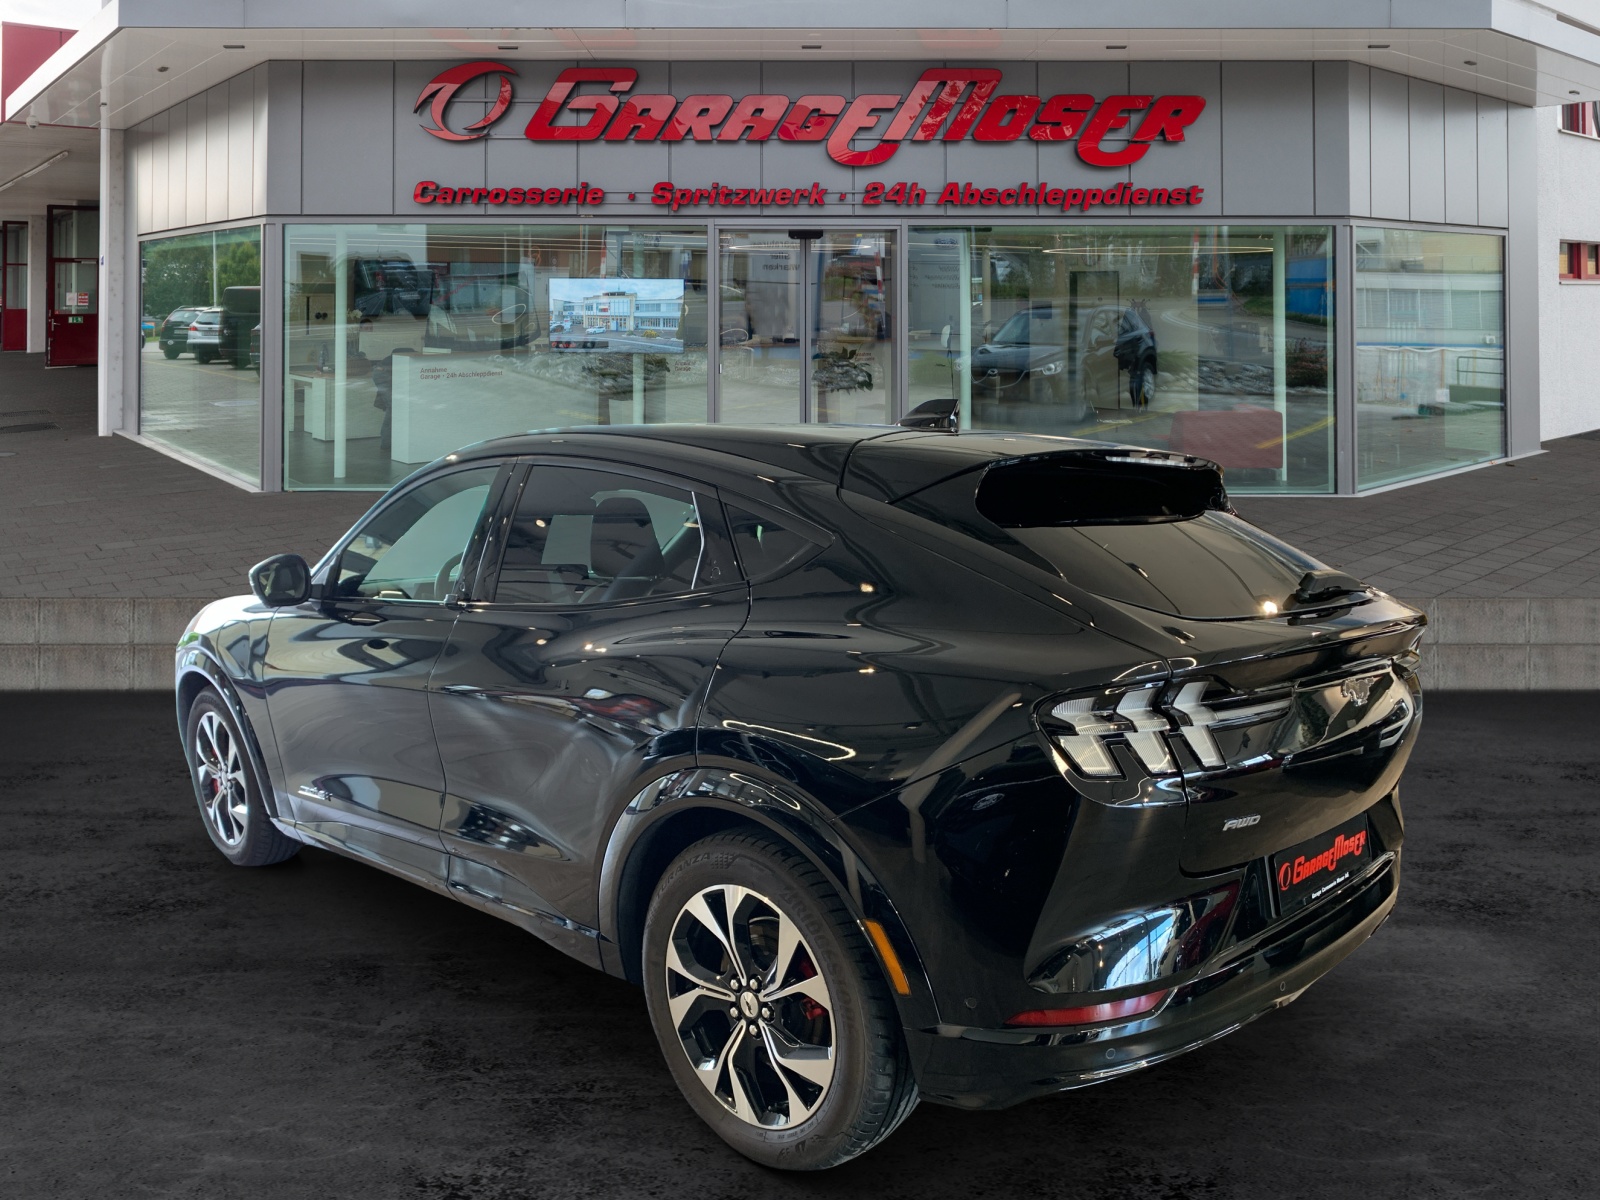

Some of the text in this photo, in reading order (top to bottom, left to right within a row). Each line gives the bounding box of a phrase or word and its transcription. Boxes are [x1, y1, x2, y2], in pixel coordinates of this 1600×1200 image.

[413, 181, 1204, 211] Carrosserie Spritzwerk 24h Abschleppdienst
[420, 366, 448, 374] Annahme
[1223, 815, 1261, 831] AWD
[656, 851, 712, 900] TURANZA
